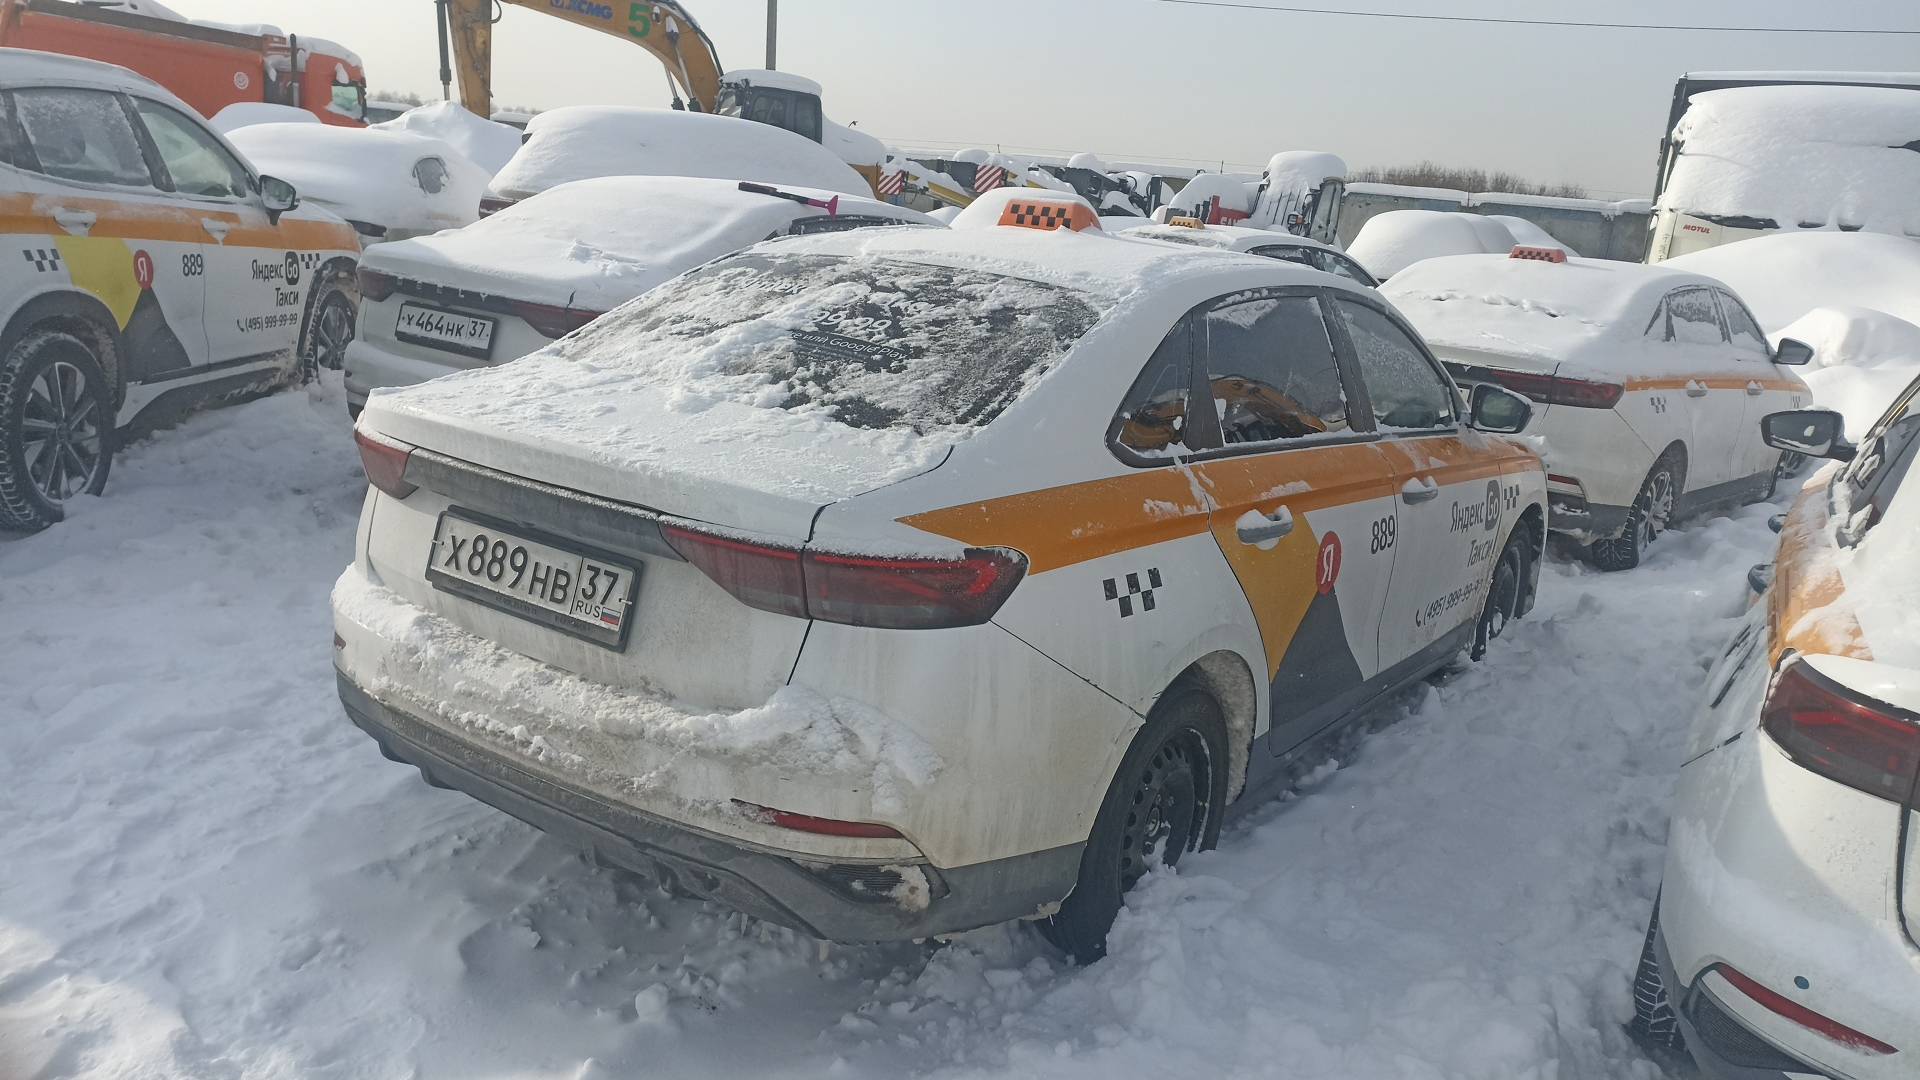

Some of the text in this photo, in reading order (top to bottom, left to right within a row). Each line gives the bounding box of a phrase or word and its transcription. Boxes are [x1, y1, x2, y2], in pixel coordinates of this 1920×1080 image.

[628, 2, 652, 38] 5
[1683, 224, 1711, 234] MOTUL
[137, 257, 148, 282] Я
[182, 253, 203, 277] 889
[251, 255, 299, 282] Яндекс Go
[274, 287, 299, 307] Такси
[245, 313, 298, 332] (495) 999-99-99
[469, 320, 487, 338] 37
[829, 338, 877, 355] Google
[876, 346, 908, 360] Play
[1450, 486, 1499, 533] Яндекс Go
[1371, 514, 1396, 555] 889
[1320, 543, 1335, 585] Я
[1467, 538, 1494, 569] Такси
[581, 564, 619, 605] 37
[575, 600, 601, 619] RUS
[1423, 597, 1447, 627] (495)
